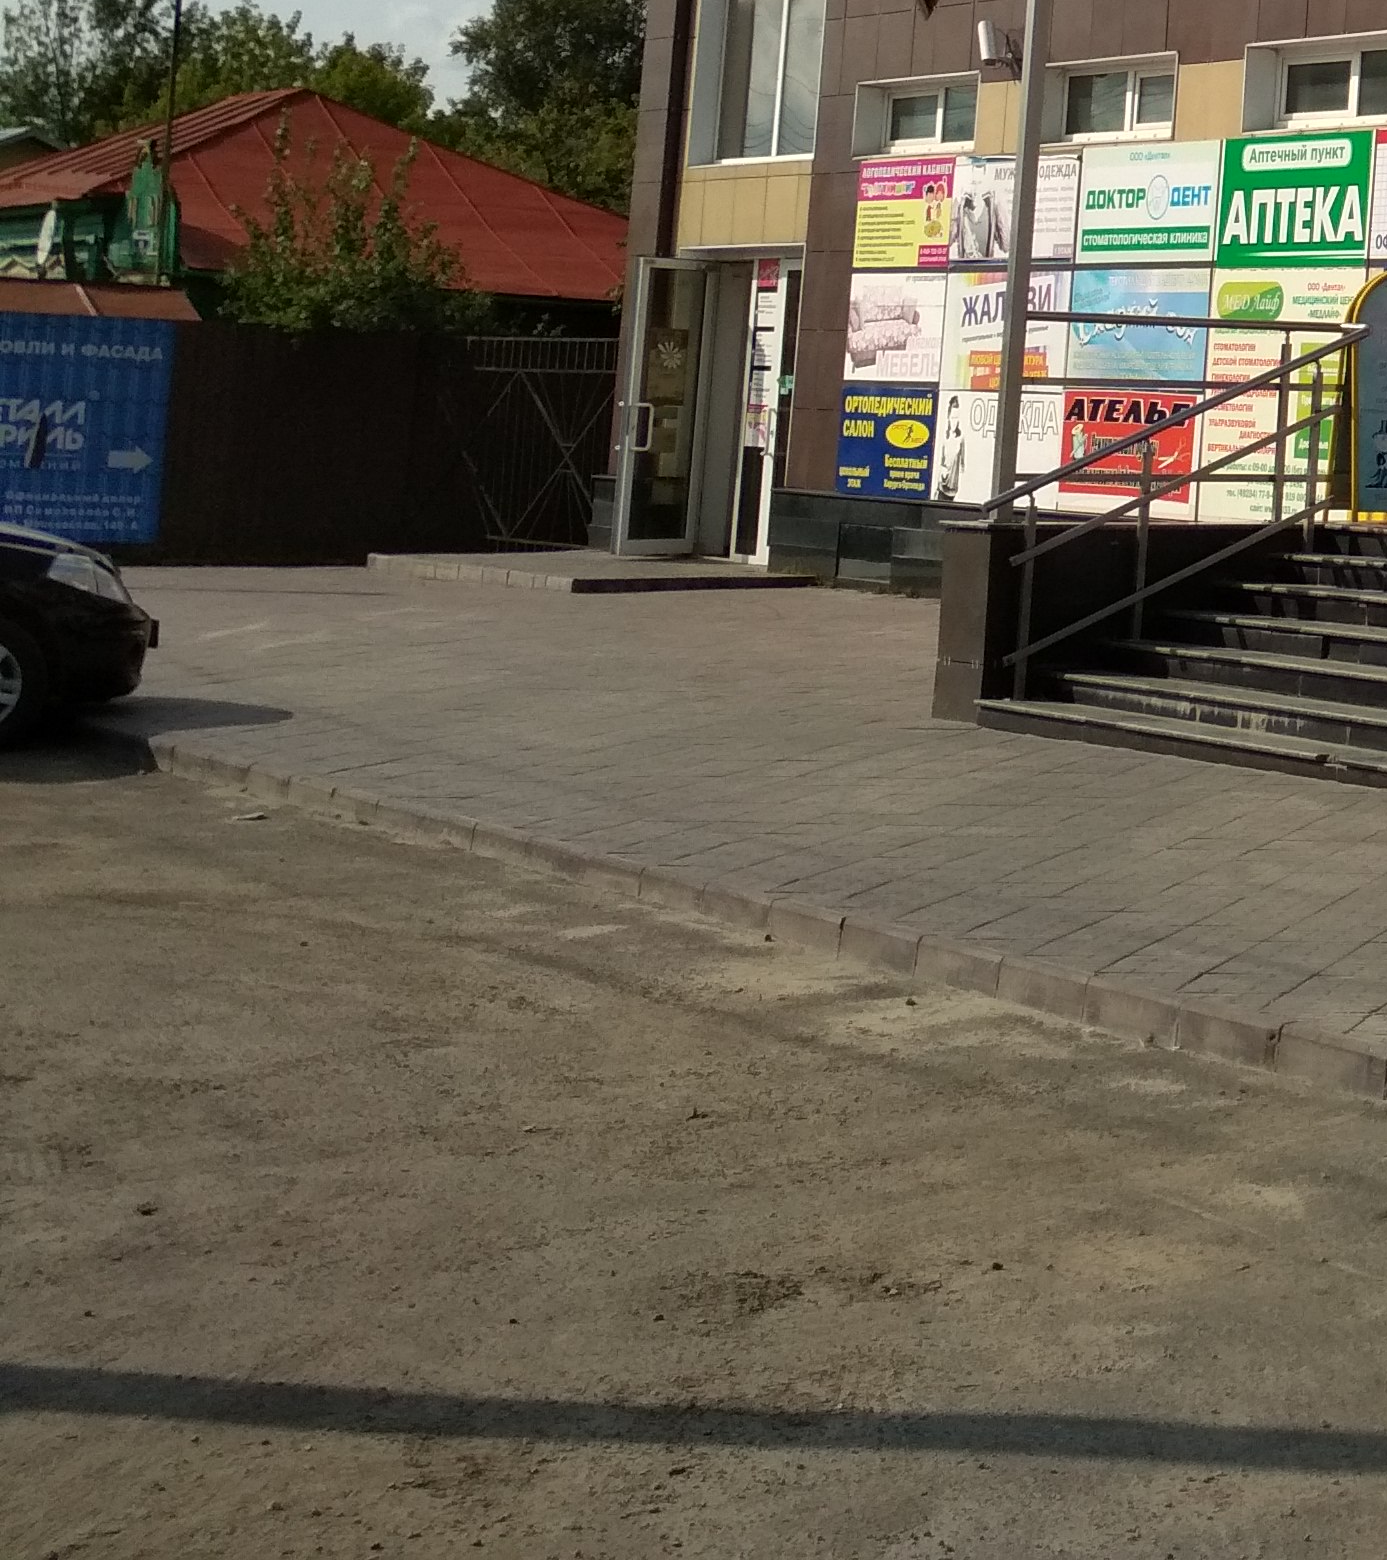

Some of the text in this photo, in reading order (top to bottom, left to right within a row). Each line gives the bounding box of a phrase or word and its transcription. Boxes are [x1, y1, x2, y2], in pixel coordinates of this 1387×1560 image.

[1249, 145, 1345, 163] Аптечный пункт
[1039, 163, 1077, 182] ОДЕЖДА
[1085, 188, 1146, 210] ДОКТОР
[1170, 186, 1211, 207] ДЕНТ
[1222, 185, 1363, 244] АПТЕКА
[1083, 232, 1207, 246] стоматологическая клиника
[1308, 283, 1320, 291] ООО
[961, 283, 1054, 328] ЖАЛЗИ
[1292, 295, 1338, 306] МЕДИЦИНСКИЙ
[62, 343, 75, 356] И
[82, 344, 163, 361] ФАСАДА
[875, 351, 939, 378] МЕБЕЛЬ
[845, 394, 933, 417] ОРТОПЕДИЧЕСКИЙ
[843, 419, 875, 438] САЛОН
